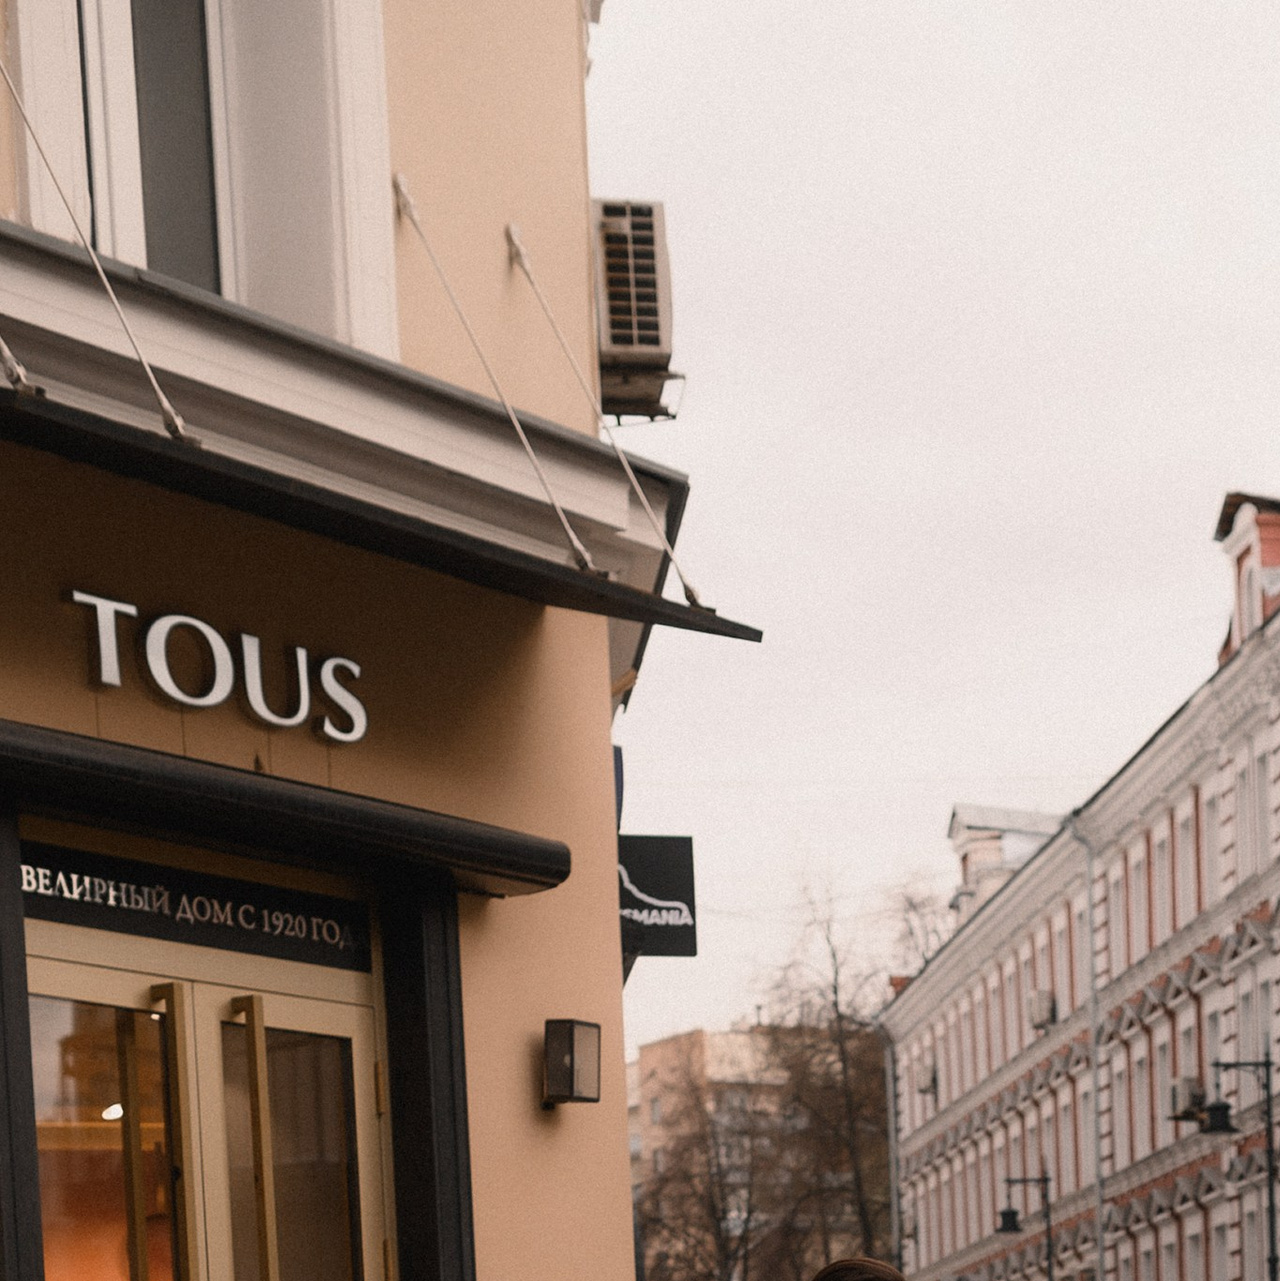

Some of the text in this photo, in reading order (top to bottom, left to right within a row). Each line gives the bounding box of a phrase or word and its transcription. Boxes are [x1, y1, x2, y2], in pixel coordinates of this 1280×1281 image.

[72, 589, 368, 743] TOUS
[174, 893, 234, 927] ДОМ
[261, 908, 307, 938] 1920
